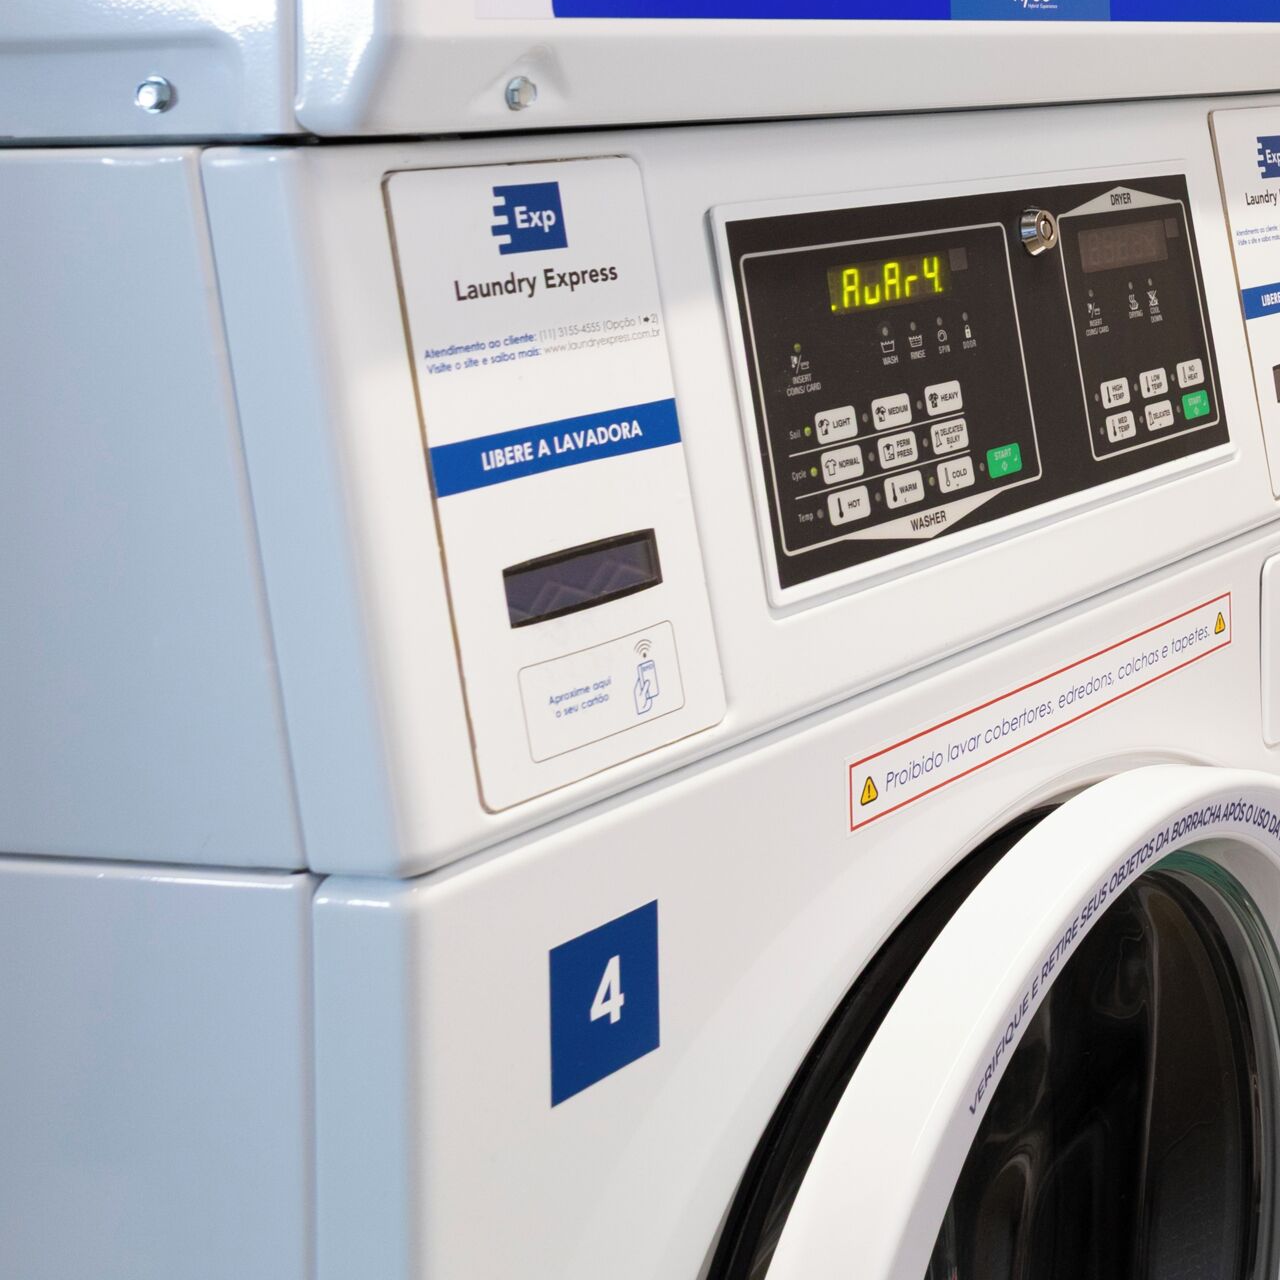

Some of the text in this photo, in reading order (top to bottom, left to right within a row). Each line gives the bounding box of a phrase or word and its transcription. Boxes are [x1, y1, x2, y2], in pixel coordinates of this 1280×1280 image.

[1110, 192, 1132, 206] DRYER
[1245, 189, 1278, 207] Laundry
[514, 206, 556, 233] Exp
[454, 266, 618, 302] Laundry Express
[882, 355, 899, 366] WASH
[910, 350, 927, 360] RINSE
[940, 391, 959, 403] HEAVY
[887, 404, 909, 416] MEDIUM
[832, 417, 851, 429] LIGHT
[481, 419, 643, 472] LIBERE A LAVADORA
[896, 437, 911, 448] PERM
[897, 448, 914, 459] PRESS
[993, 448, 1012, 461] START
[838, 457, 861, 469] NORMAL
[952, 468, 968, 480] COLD
[899, 483, 918, 495] WARM
[847, 498, 861, 509] HOT
[910, 510, 947, 532] WASHER
[885, 625, 1211, 792] Proibido lavar cobertores, edredons, colchas e tapetes.
[969, 992, 1030, 1115] VERIFIQUE
[1031, 976, 1039, 1001] E
[1041, 917, 1080, 985] RETIRE
[1080, 882, 1108, 929] SEUS
[1109, 838, 1155, 891] OBJETOS
[1155, 828, 1171, 853] DA
[1171, 804, 1222, 841] BORRACHA
[1222, 797, 1247, 823] APÓS
[1246, 805, 1253, 821] O
[1253, 806, 1270, 829] USO
[1268, 816, 1280, 838] DA
[590, 954, 625, 1024] 4
